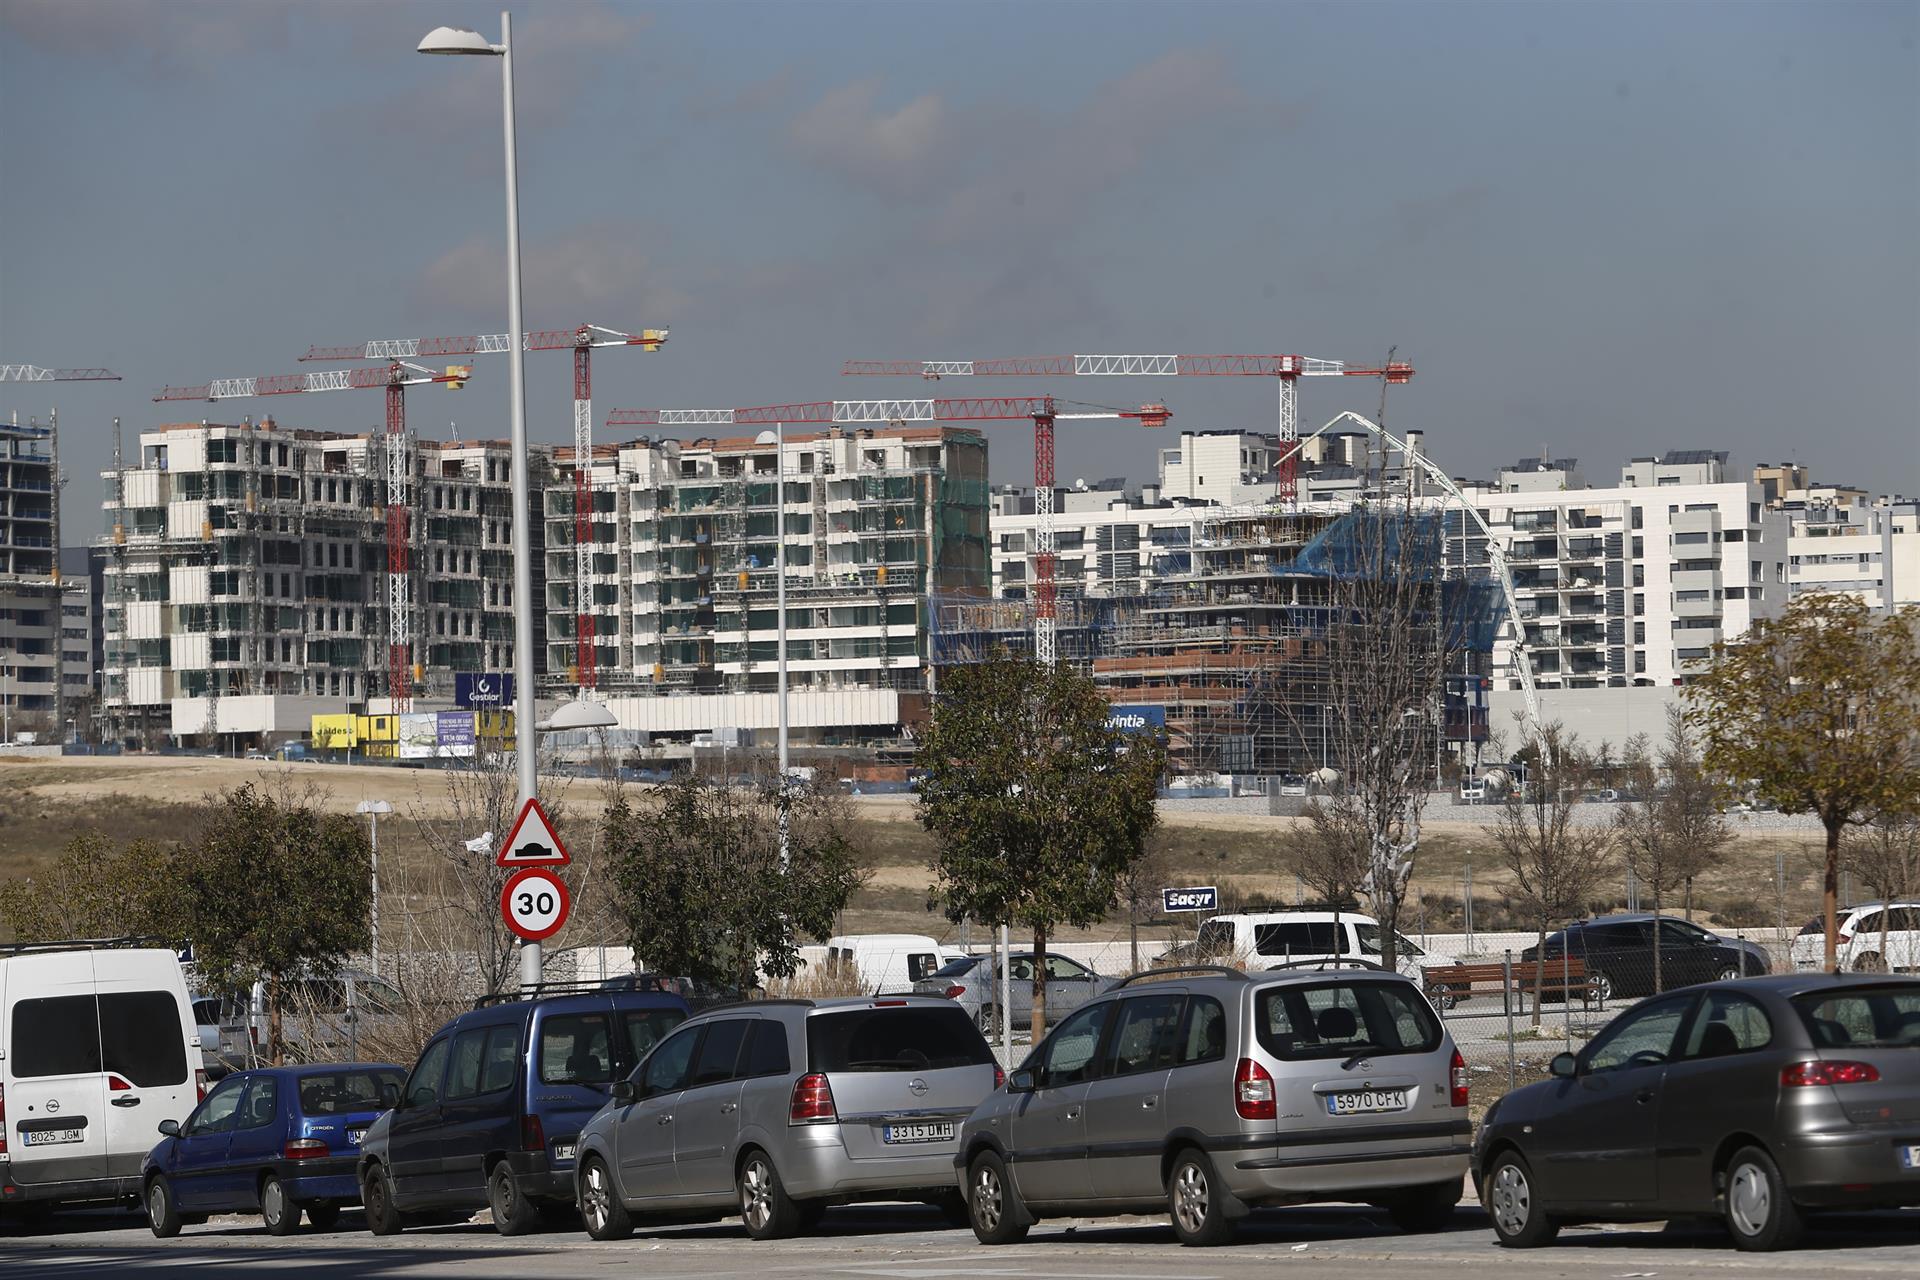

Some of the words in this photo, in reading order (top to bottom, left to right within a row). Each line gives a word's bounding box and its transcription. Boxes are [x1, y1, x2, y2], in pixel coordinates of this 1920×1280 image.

[518, 893, 554, 915] 30
[1169, 893, 1212, 907] Sacyr
[1337, 1094, 1372, 1109] 5970
[1376, 1091, 1402, 1107] CFK
[30, 1131, 56, 1142] 8025
[61, 1129, 80, 1140] JGM
[893, 1125, 924, 1138] 3315
[927, 1123, 951, 1136] DWH
